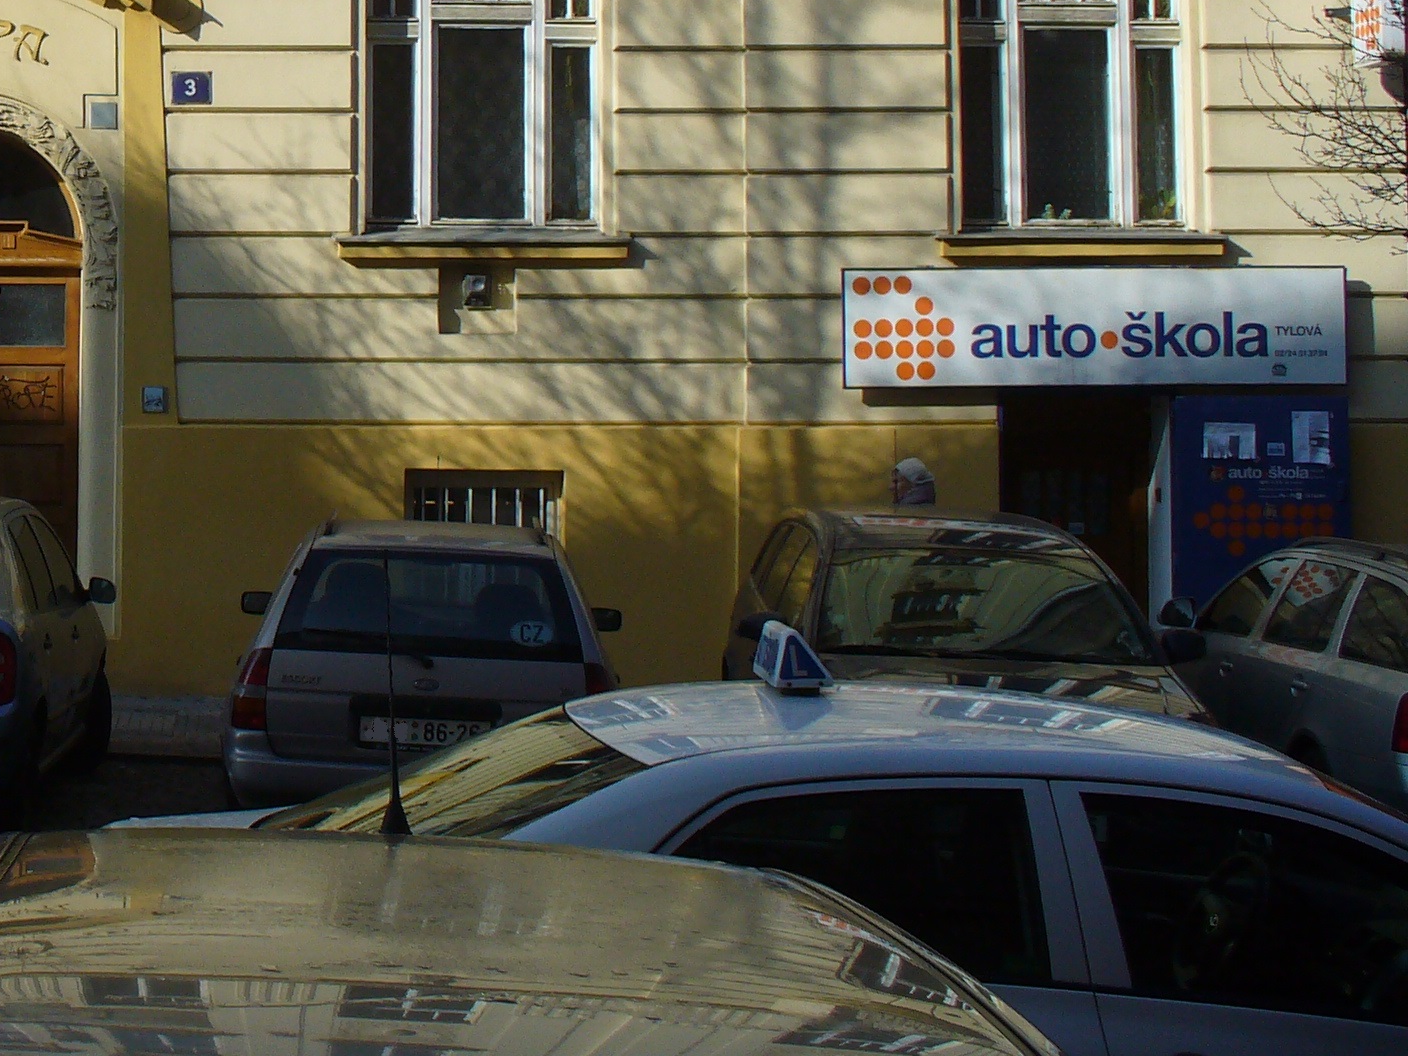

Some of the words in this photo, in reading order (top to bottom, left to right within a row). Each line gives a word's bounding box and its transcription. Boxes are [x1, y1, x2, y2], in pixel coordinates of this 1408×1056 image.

[184, 78, 197, 96] 3
[970, 314, 1097, 359] auto
[1120, 310, 1269, 359] škola
[1274, 323, 1323, 336] TYLOVÁ
[1227, 466, 1262, 480] auto
[1268, 465, 1309, 480] škola
[520, 623, 544, 643] CZ
[788, 643, 808, 677] L
